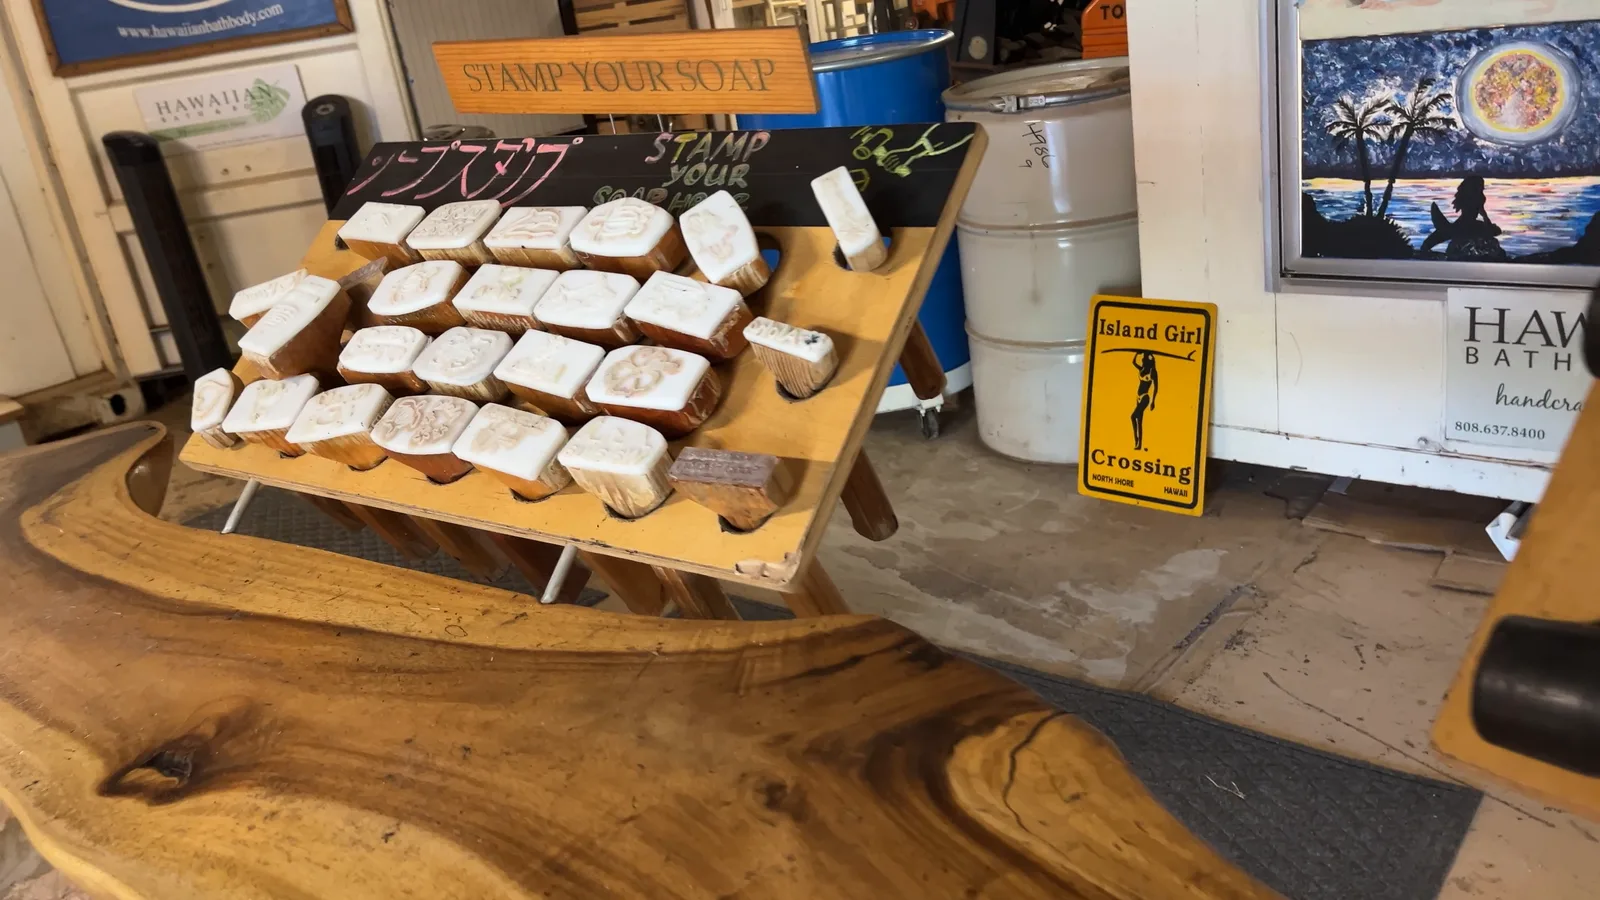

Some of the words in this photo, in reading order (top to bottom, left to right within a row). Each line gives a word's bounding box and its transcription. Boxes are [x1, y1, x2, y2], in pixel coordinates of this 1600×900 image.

[117, 3, 284, 38] www.hawaiianbathbody.com
[463, 62, 563, 93] STAMP
[570, 60, 674, 93] YOUR
[675, 58, 775, 92] SOAP
[155, 83, 275, 115] HAWAIIAN
[645, 131, 771, 164] STAMP
[661, 162, 750, 188] YOUR
[1099, 319, 1158, 340] Island
[1164, 324, 1202, 345] Girl
[1466, 346, 1572, 372] BATH
[1455, 421, 1546, 440] 808.637.8400
[1091, 449, 1192, 486] Crossing
[1092, 473, 1114, 483] NORTH
[1114, 476, 1135, 488] SHORE
[1163, 486, 1188, 498] HAWAII
